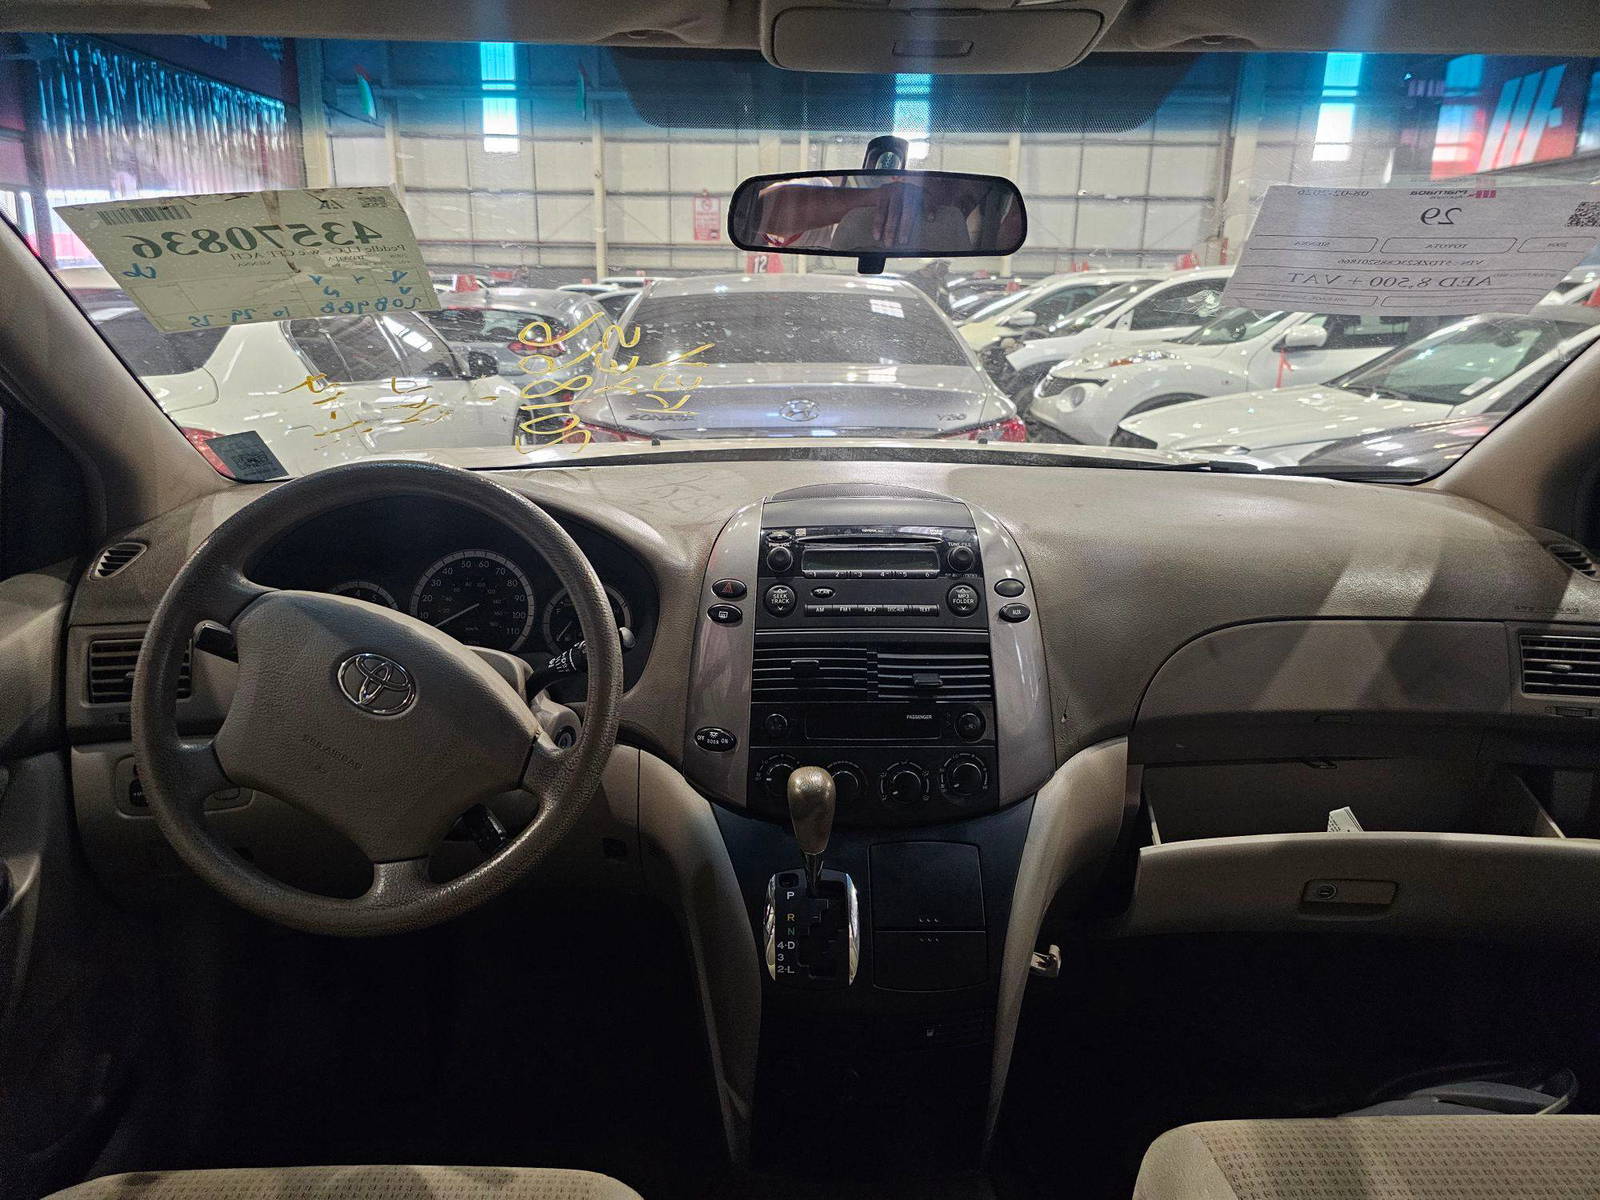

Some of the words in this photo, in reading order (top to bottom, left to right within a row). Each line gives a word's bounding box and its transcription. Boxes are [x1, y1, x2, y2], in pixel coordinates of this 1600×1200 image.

[460, 560, 472, 568] 50
[478, 560, 490, 568] 60
[787, 892, 795, 900] P
[787, 913, 795, 922] R
[787, 927, 796, 936] N
[777, 953, 785, 962] 3
